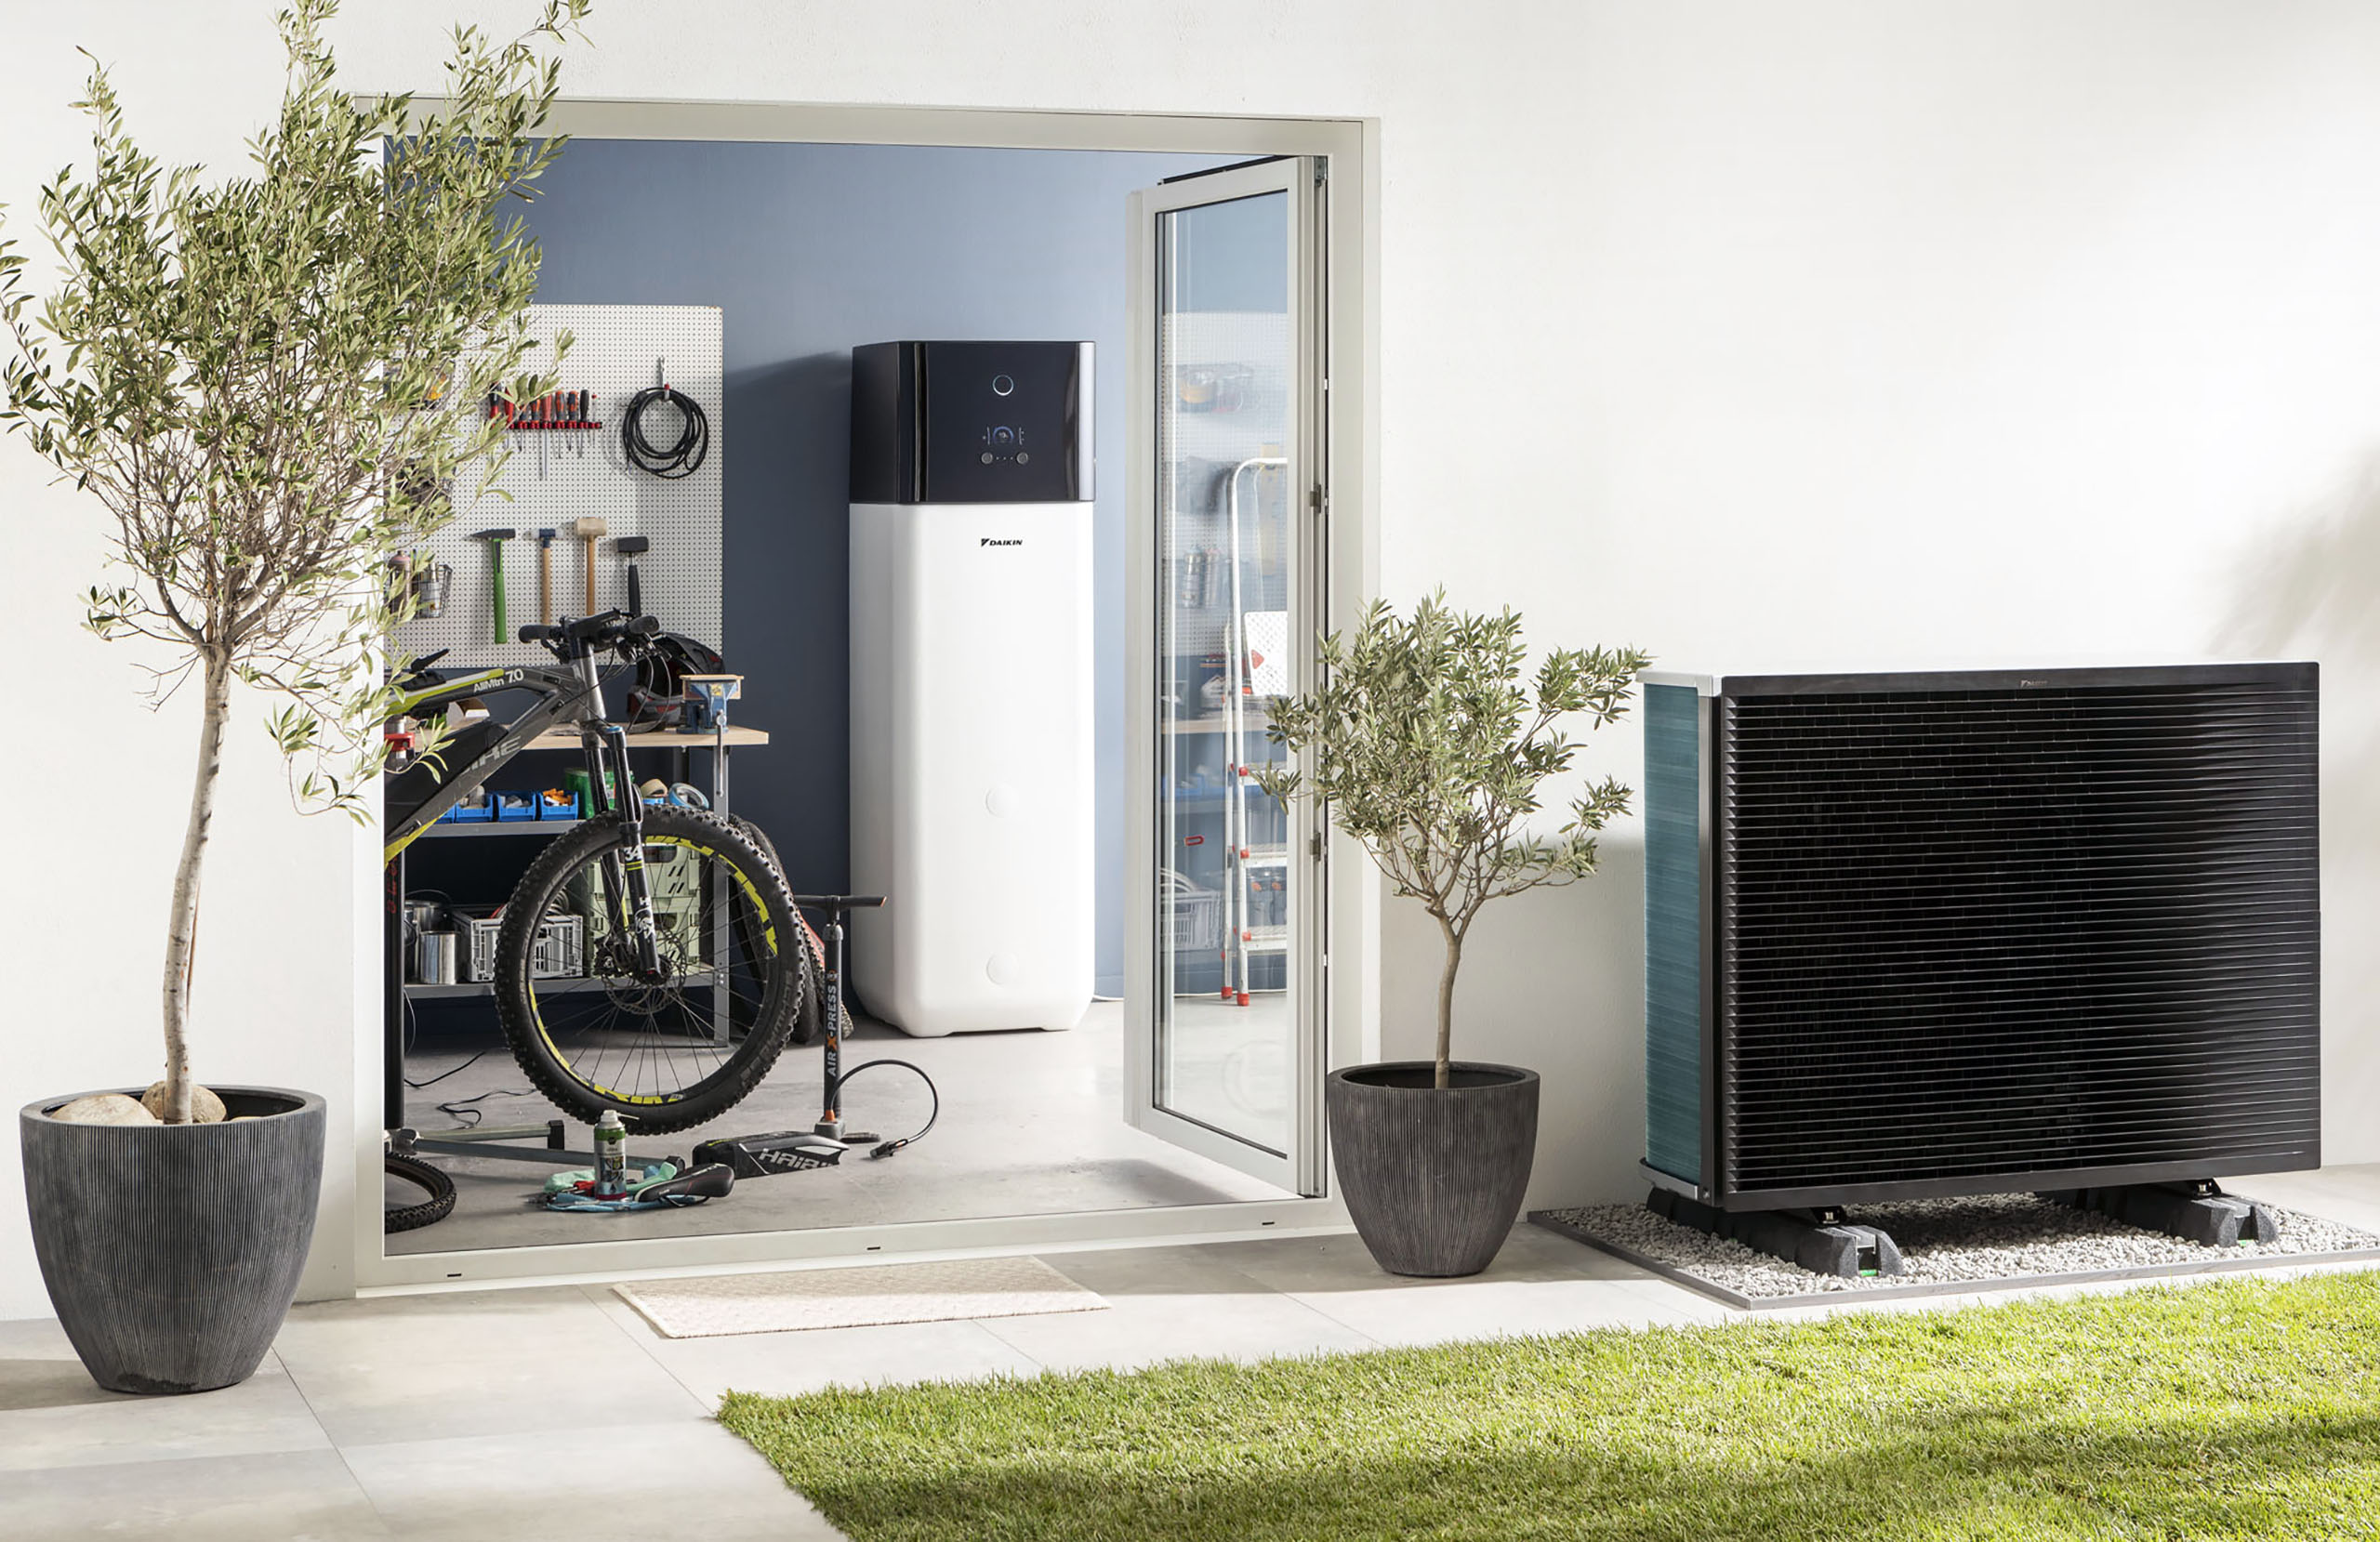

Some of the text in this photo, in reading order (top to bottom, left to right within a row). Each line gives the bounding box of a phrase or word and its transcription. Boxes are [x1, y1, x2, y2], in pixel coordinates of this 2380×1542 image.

[624, 844, 642, 862] 34
[826, 985, 838, 1051] X-PRESS
[826, 1051, 838, 1077] AIR
